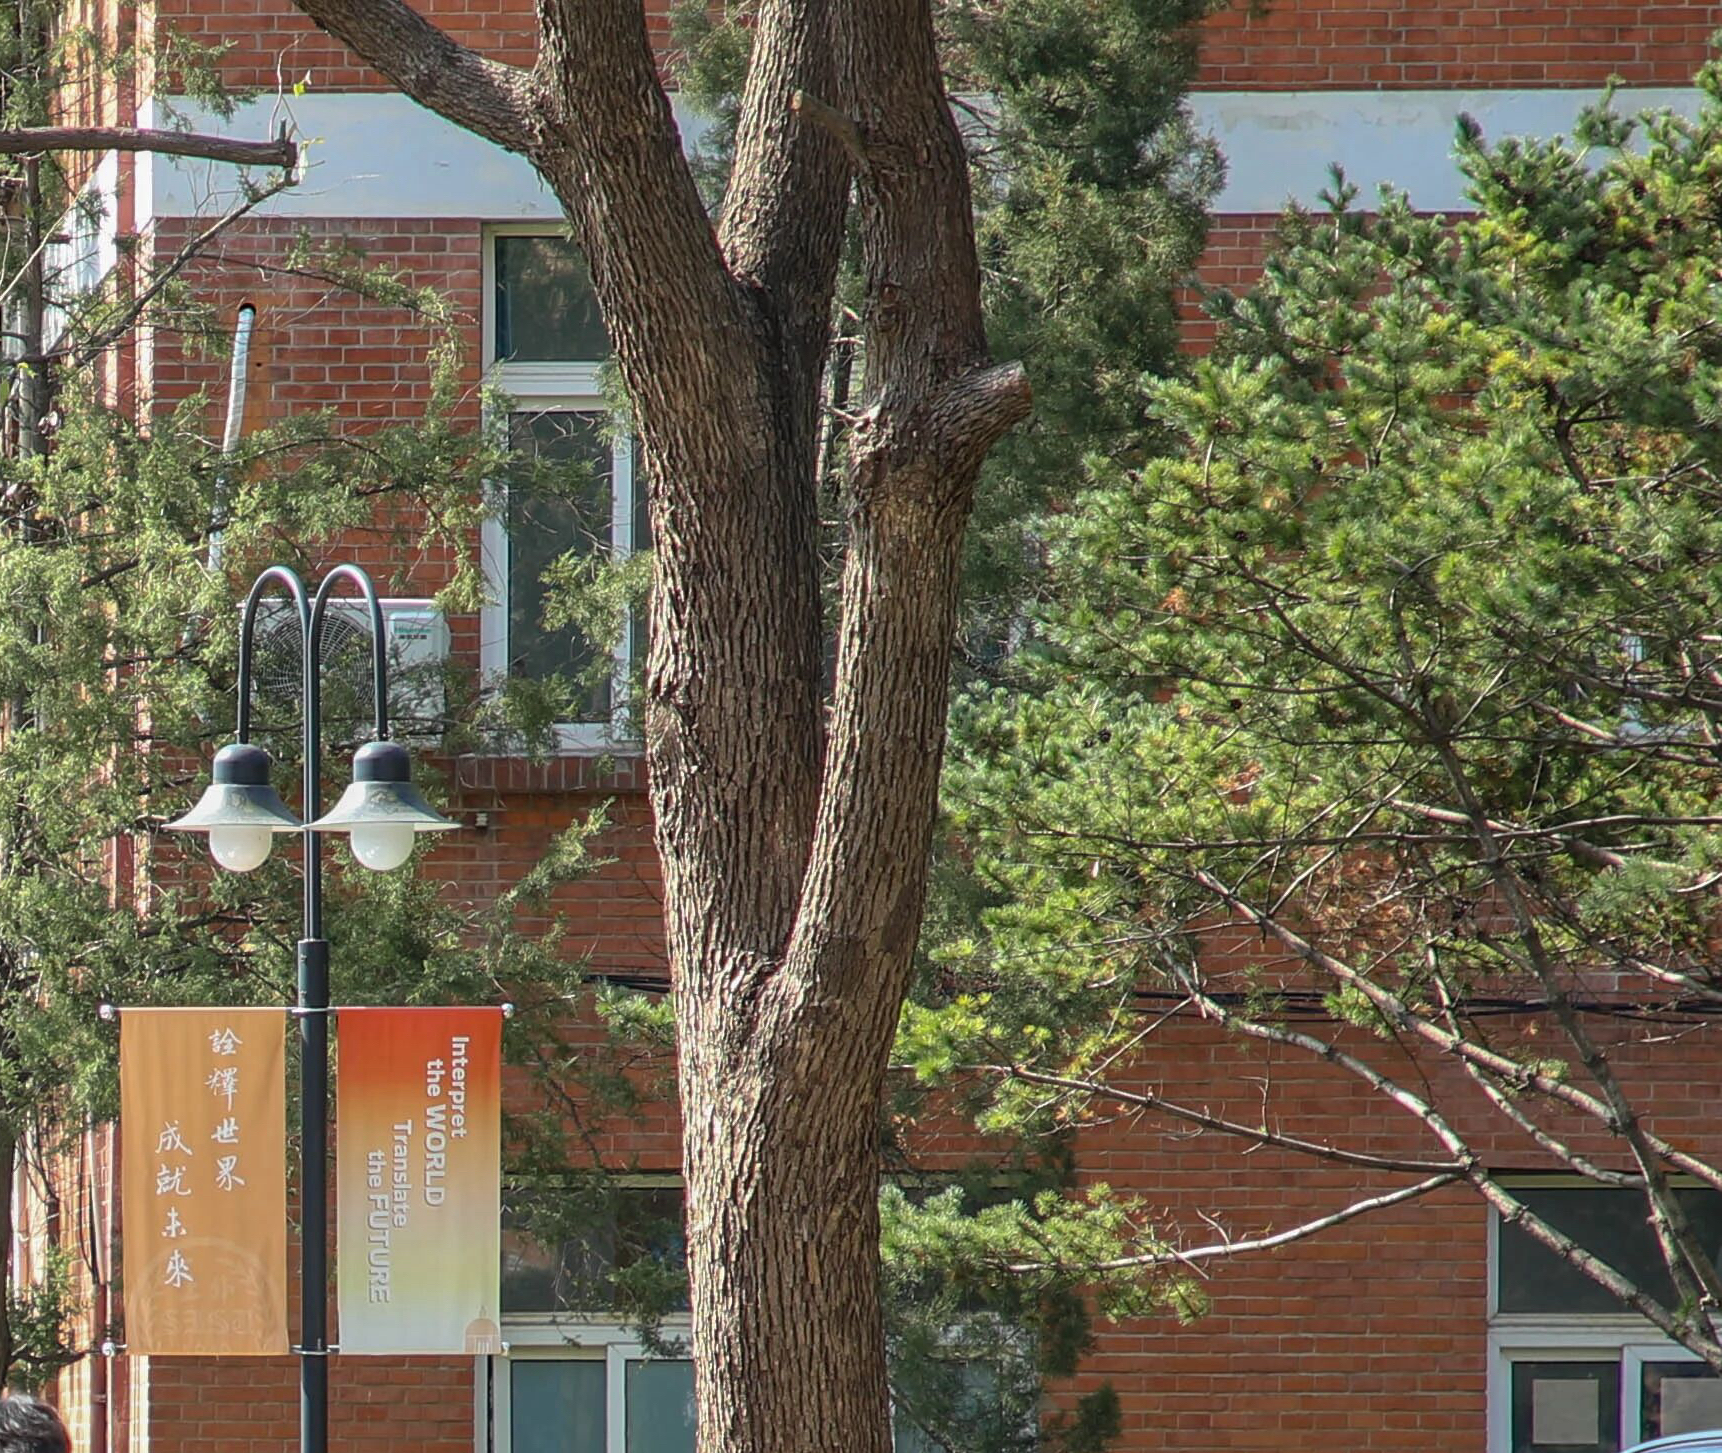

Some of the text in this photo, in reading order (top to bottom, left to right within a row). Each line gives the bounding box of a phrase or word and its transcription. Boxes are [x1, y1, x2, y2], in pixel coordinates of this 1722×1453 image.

[424, 1058, 447, 1207] the WORLD
[448, 1036, 470, 1138] Interpret
[367, 1150, 389, 1303] the FUTURE
[392, 1119, 412, 1228] Translate
